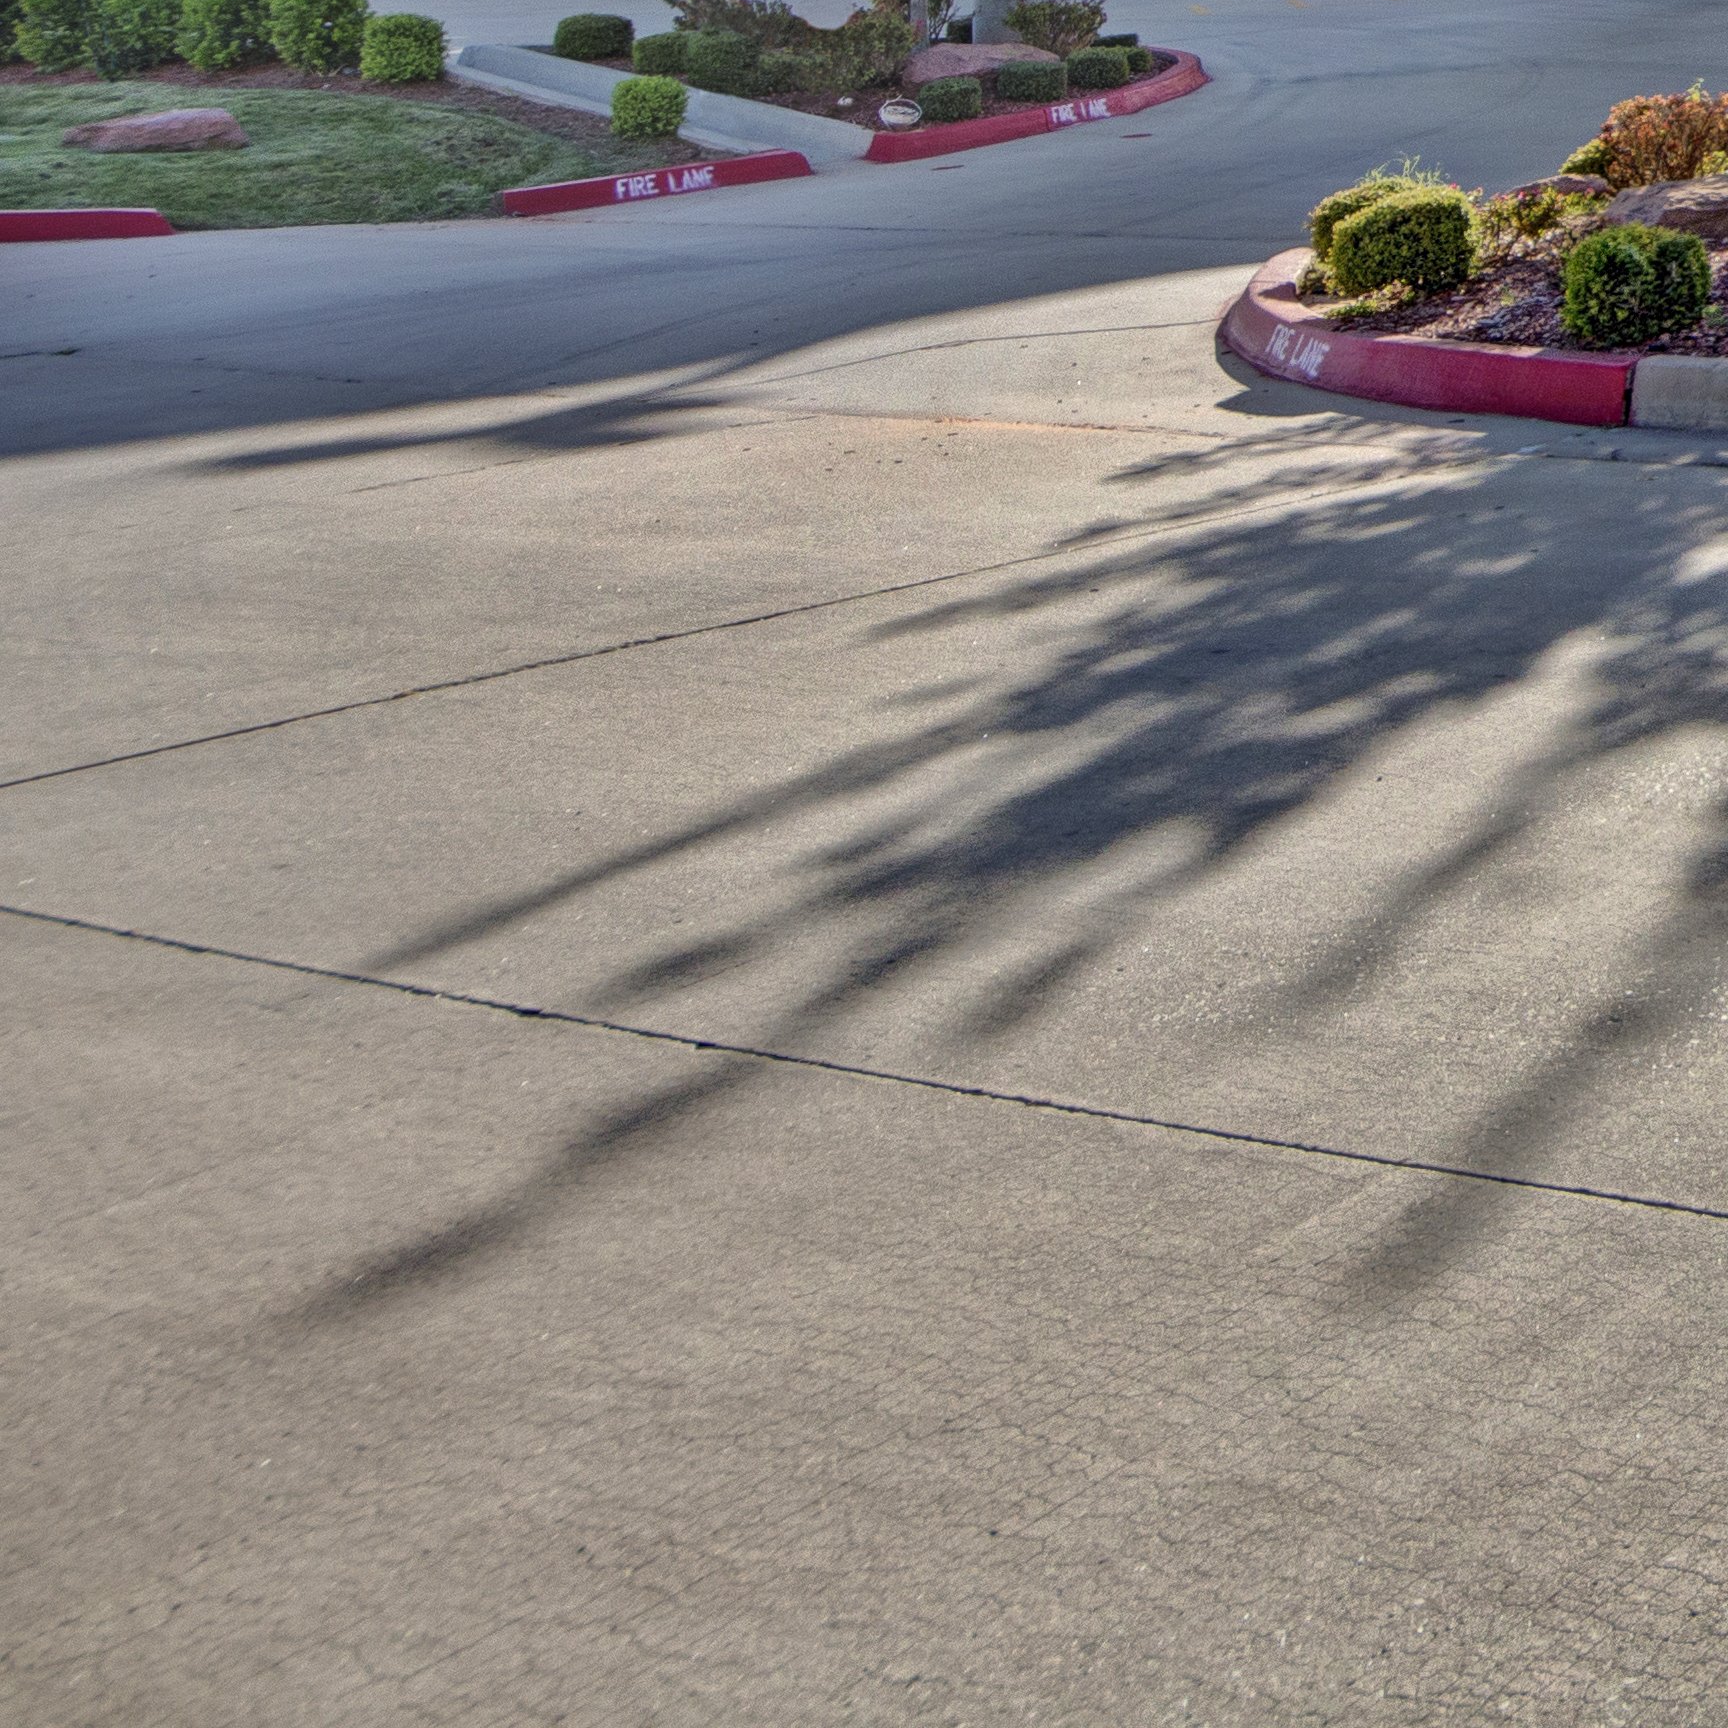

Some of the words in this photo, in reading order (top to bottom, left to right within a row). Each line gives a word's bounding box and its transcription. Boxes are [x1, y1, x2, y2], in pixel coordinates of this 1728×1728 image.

[1051, 103, 1077, 123] FIRE
[616, 174, 659, 200] FIRE
[1289, 334, 1330, 378] LANE
